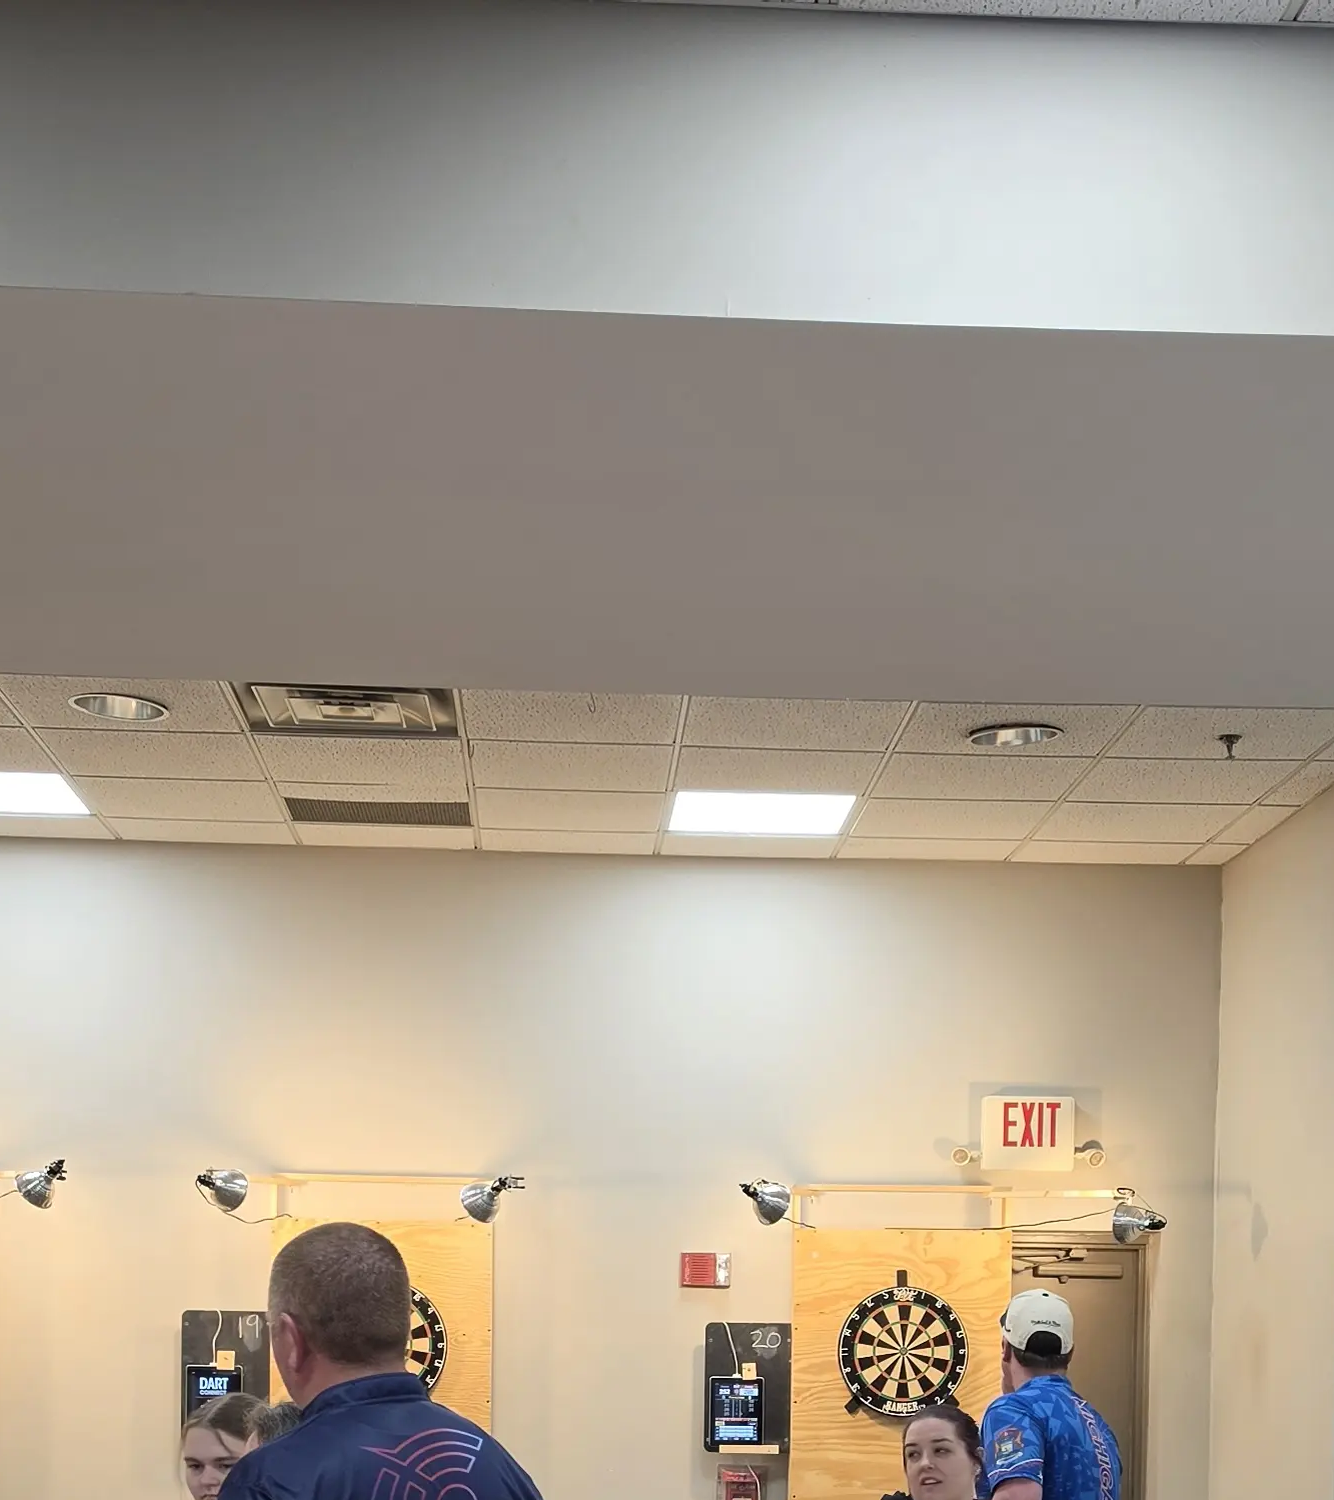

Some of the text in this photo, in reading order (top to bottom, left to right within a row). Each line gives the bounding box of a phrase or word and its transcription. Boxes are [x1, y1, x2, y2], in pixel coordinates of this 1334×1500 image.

[1003, 1102, 1061, 1147] EXIT
[239, 1314, 259, 1338] 19
[750, 1330, 782, 1348] 20
[199, 1377, 229, 1389] DART
